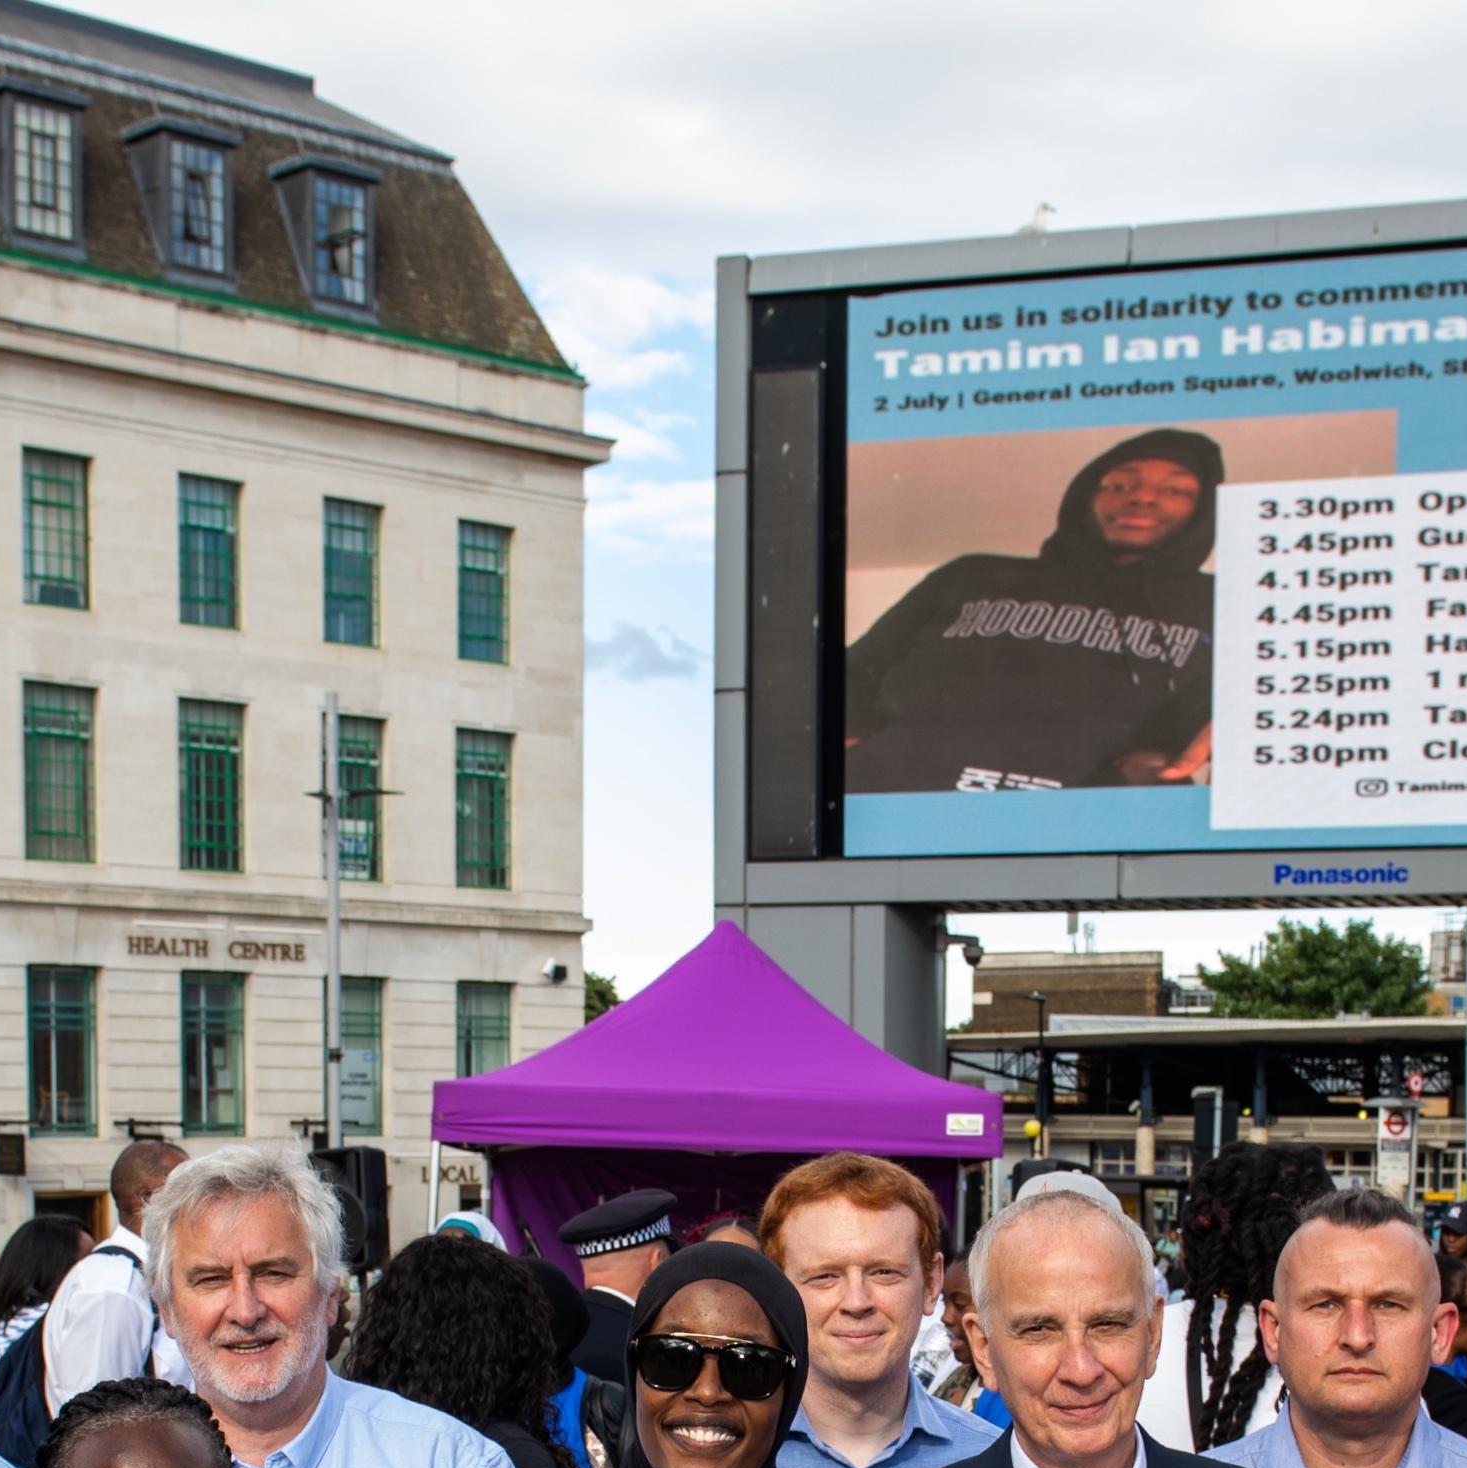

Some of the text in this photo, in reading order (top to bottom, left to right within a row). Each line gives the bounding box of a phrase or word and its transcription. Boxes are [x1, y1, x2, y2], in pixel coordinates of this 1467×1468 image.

[875, 313, 950, 338] Join
[963, 313, 1004, 332] us
[1016, 306, 1047, 328] in
[1060, 293, 1234, 324] solidarity
[1246, 291, 1282, 311] to
[874, 339, 1084, 378] Tamim
[1103, 333, 1200, 364] Ian
[873, 396, 889, 411] 2
[898, 392, 949, 411] July
[973, 384, 1071, 406] General
[1080, 378, 1175, 398] Gordon
[1184, 374, 1285, 394] Square,
[1293, 362, 1433, 386] Woolwich,
[1259, 496, 1395, 520] 3.30pm
[1258, 532, 1395, 556] 3.45pm
[1257, 567, 1394, 592] 4.15pm
[1256, 602, 1393, 627] 4.45pm
[1256, 637, 1392, 662] 5.15pm
[1255, 673, 1391, 697] 5.25pm
[1427, 670, 1442, 689] 1
[1255, 708, 1390, 732] 5.24pm
[1254, 744, 1389, 767] 5.30pm
[1274, 862, 1409, 884] Panasonic
[128, 936, 305, 962] HEALTH CENTRE
